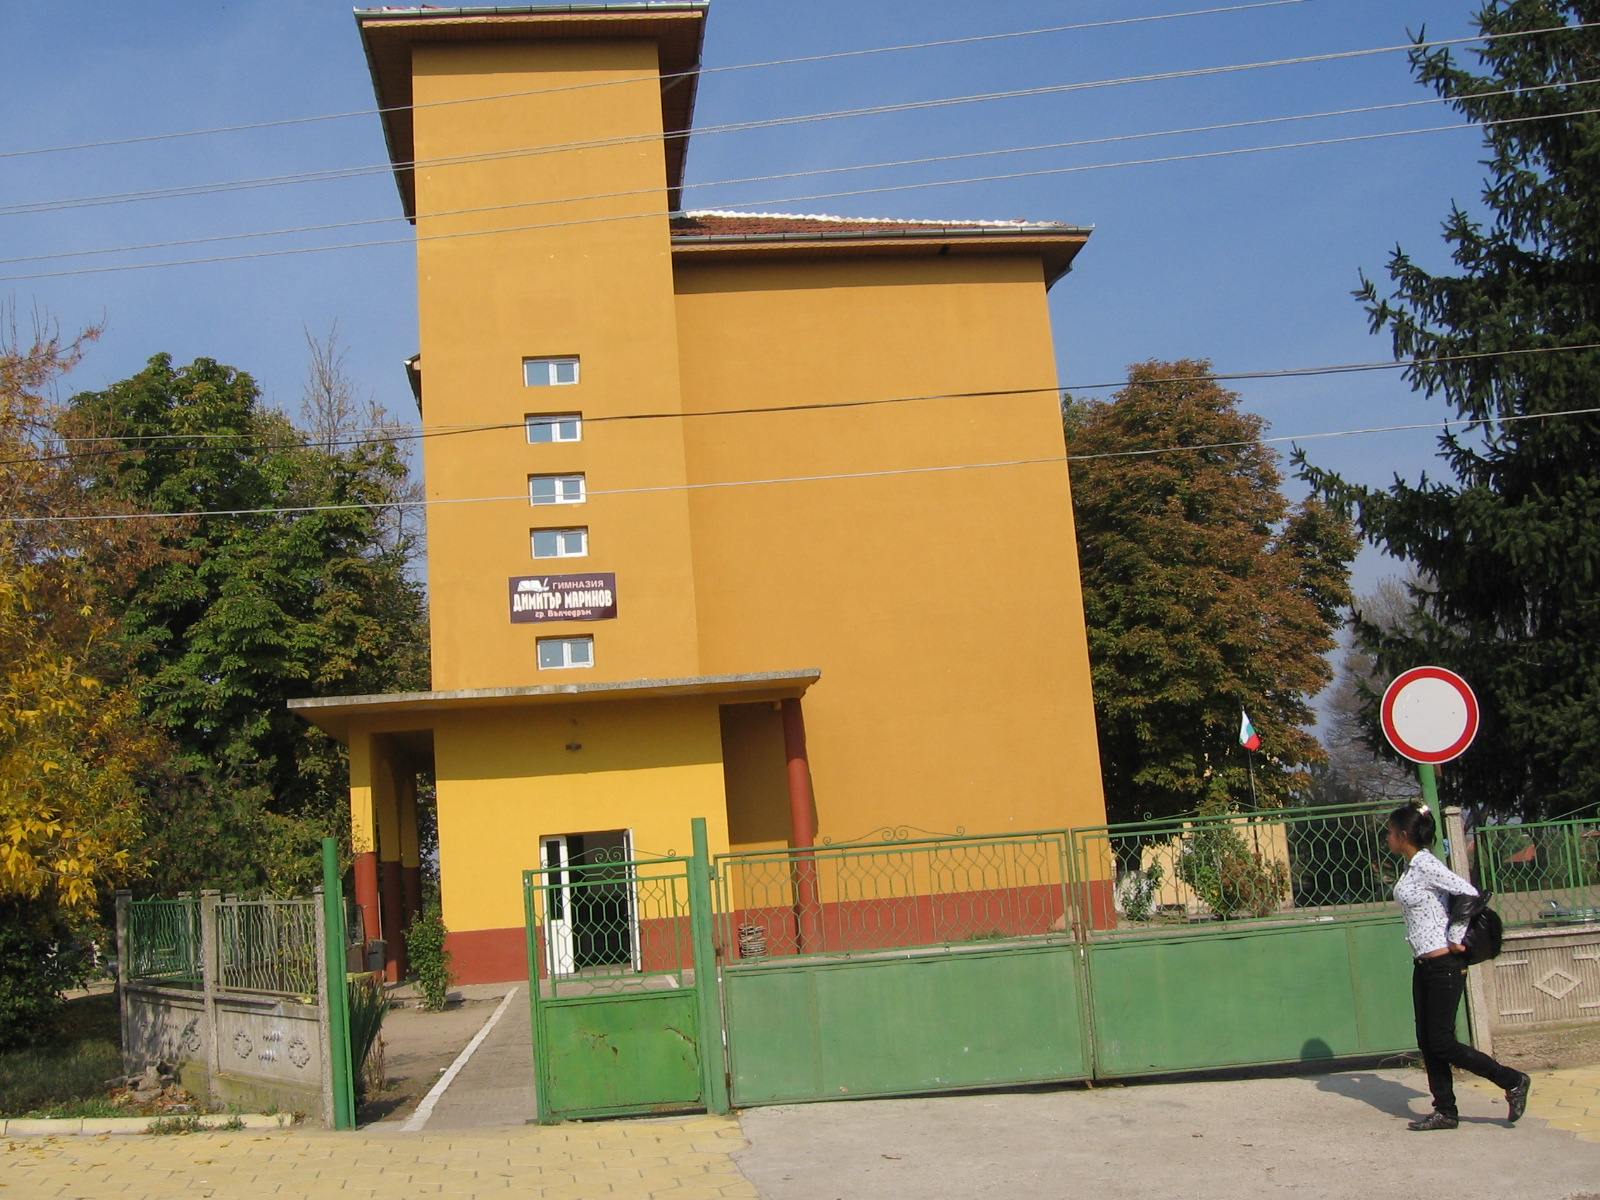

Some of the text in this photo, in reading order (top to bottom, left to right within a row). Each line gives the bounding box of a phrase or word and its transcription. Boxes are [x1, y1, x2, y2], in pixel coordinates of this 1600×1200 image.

[552, 580, 604, 590] ГИМНАЗИЯ
[513, 589, 613, 612] ДИМИТЪР МАРИНОВ
